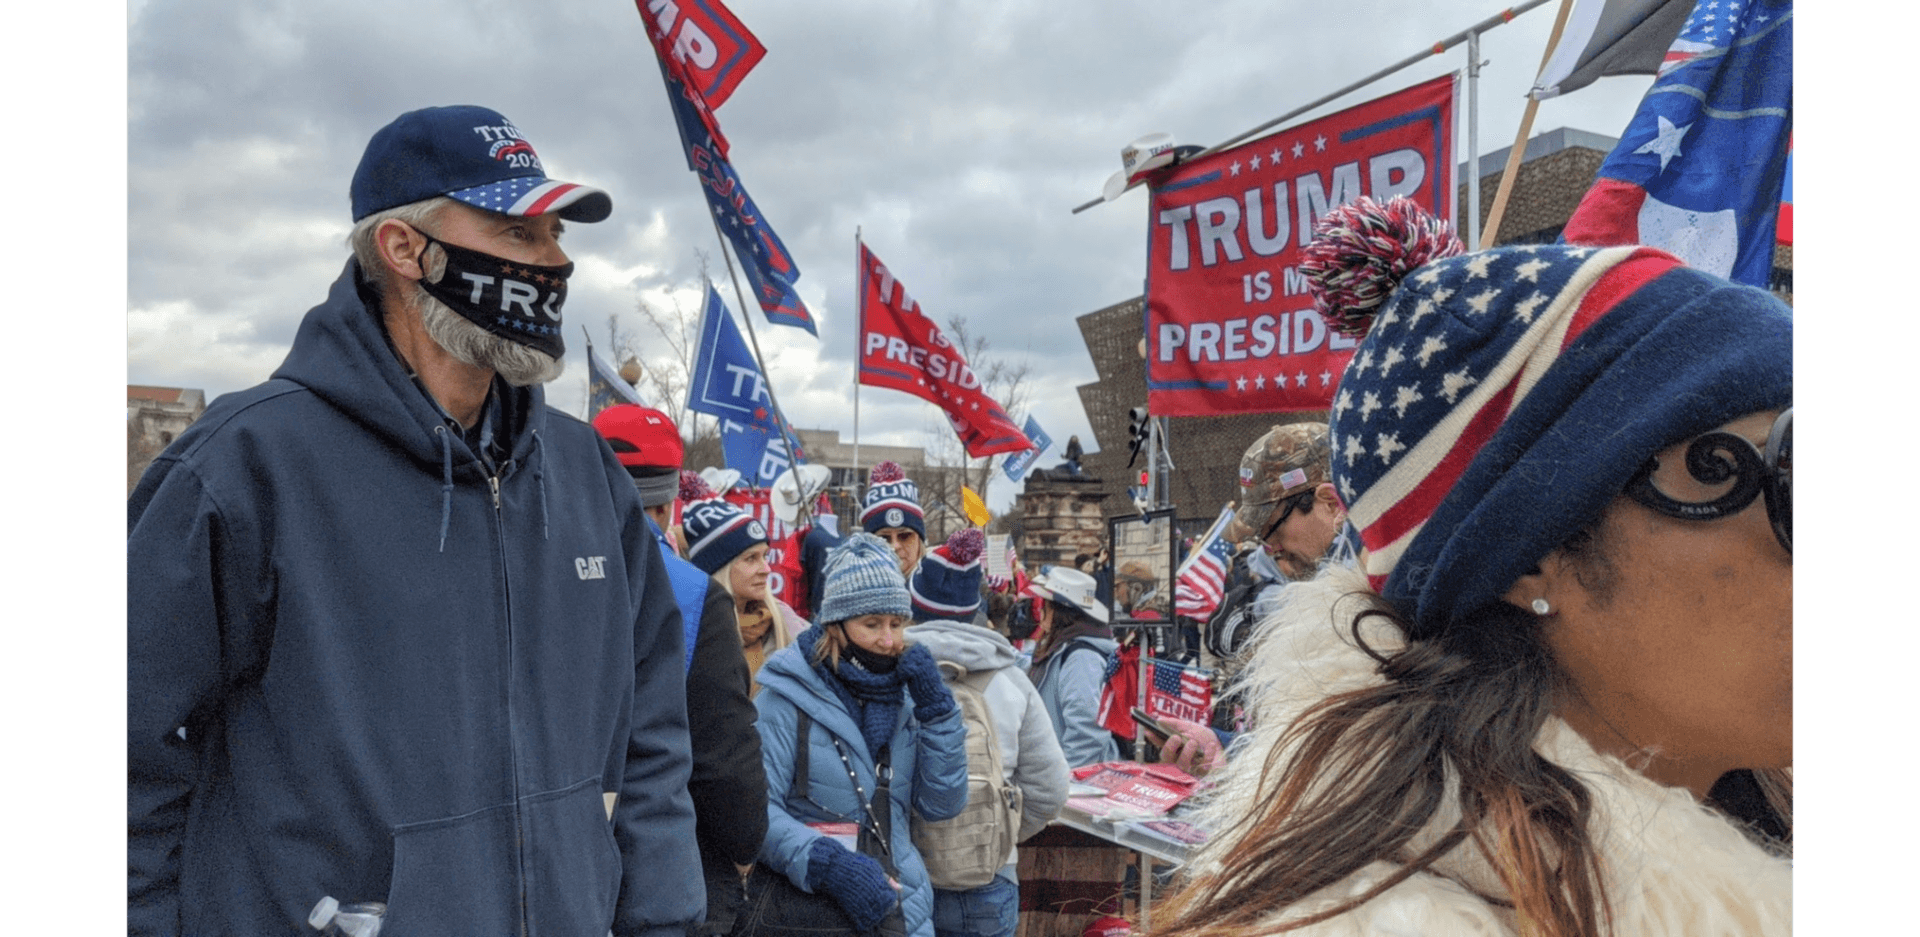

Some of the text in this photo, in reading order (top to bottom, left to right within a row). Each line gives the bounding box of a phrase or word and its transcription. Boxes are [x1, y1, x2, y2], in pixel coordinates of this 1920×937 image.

[473, 125, 525, 142] Tru
[505, 153, 544, 171] 202
[1243, 265, 1309, 303] IS M
[929, 328, 950, 349] IS
[889, 512, 900, 522] 45
[574, 556, 606, 580] CAT
[1131, 783, 1178, 800] TRUMP
